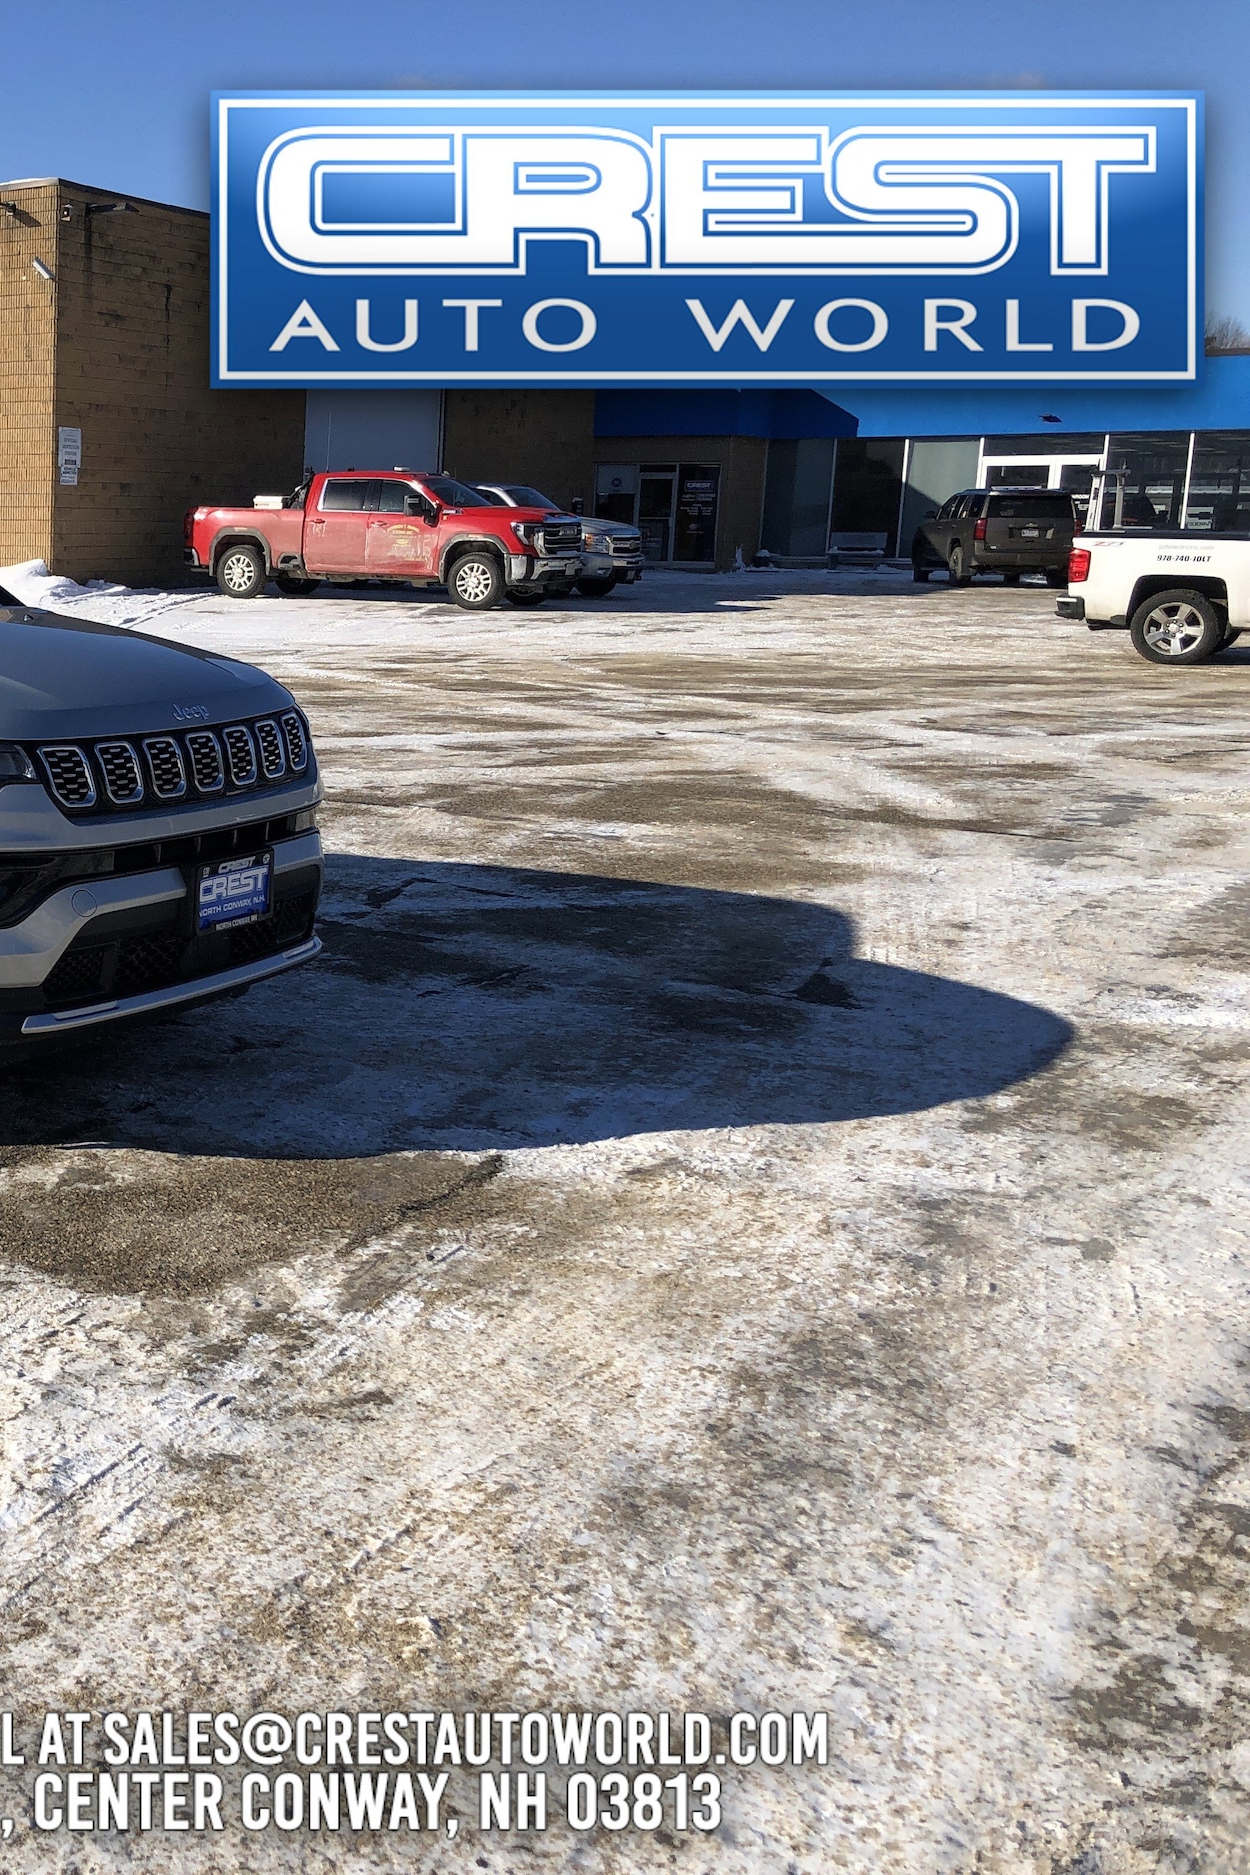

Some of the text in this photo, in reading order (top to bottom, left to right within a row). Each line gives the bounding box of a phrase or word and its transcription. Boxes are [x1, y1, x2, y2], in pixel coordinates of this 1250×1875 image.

[173, 703, 209, 720] Jeep
[218, 856, 256, 874] CREST
[199, 867, 269, 903] CREST
